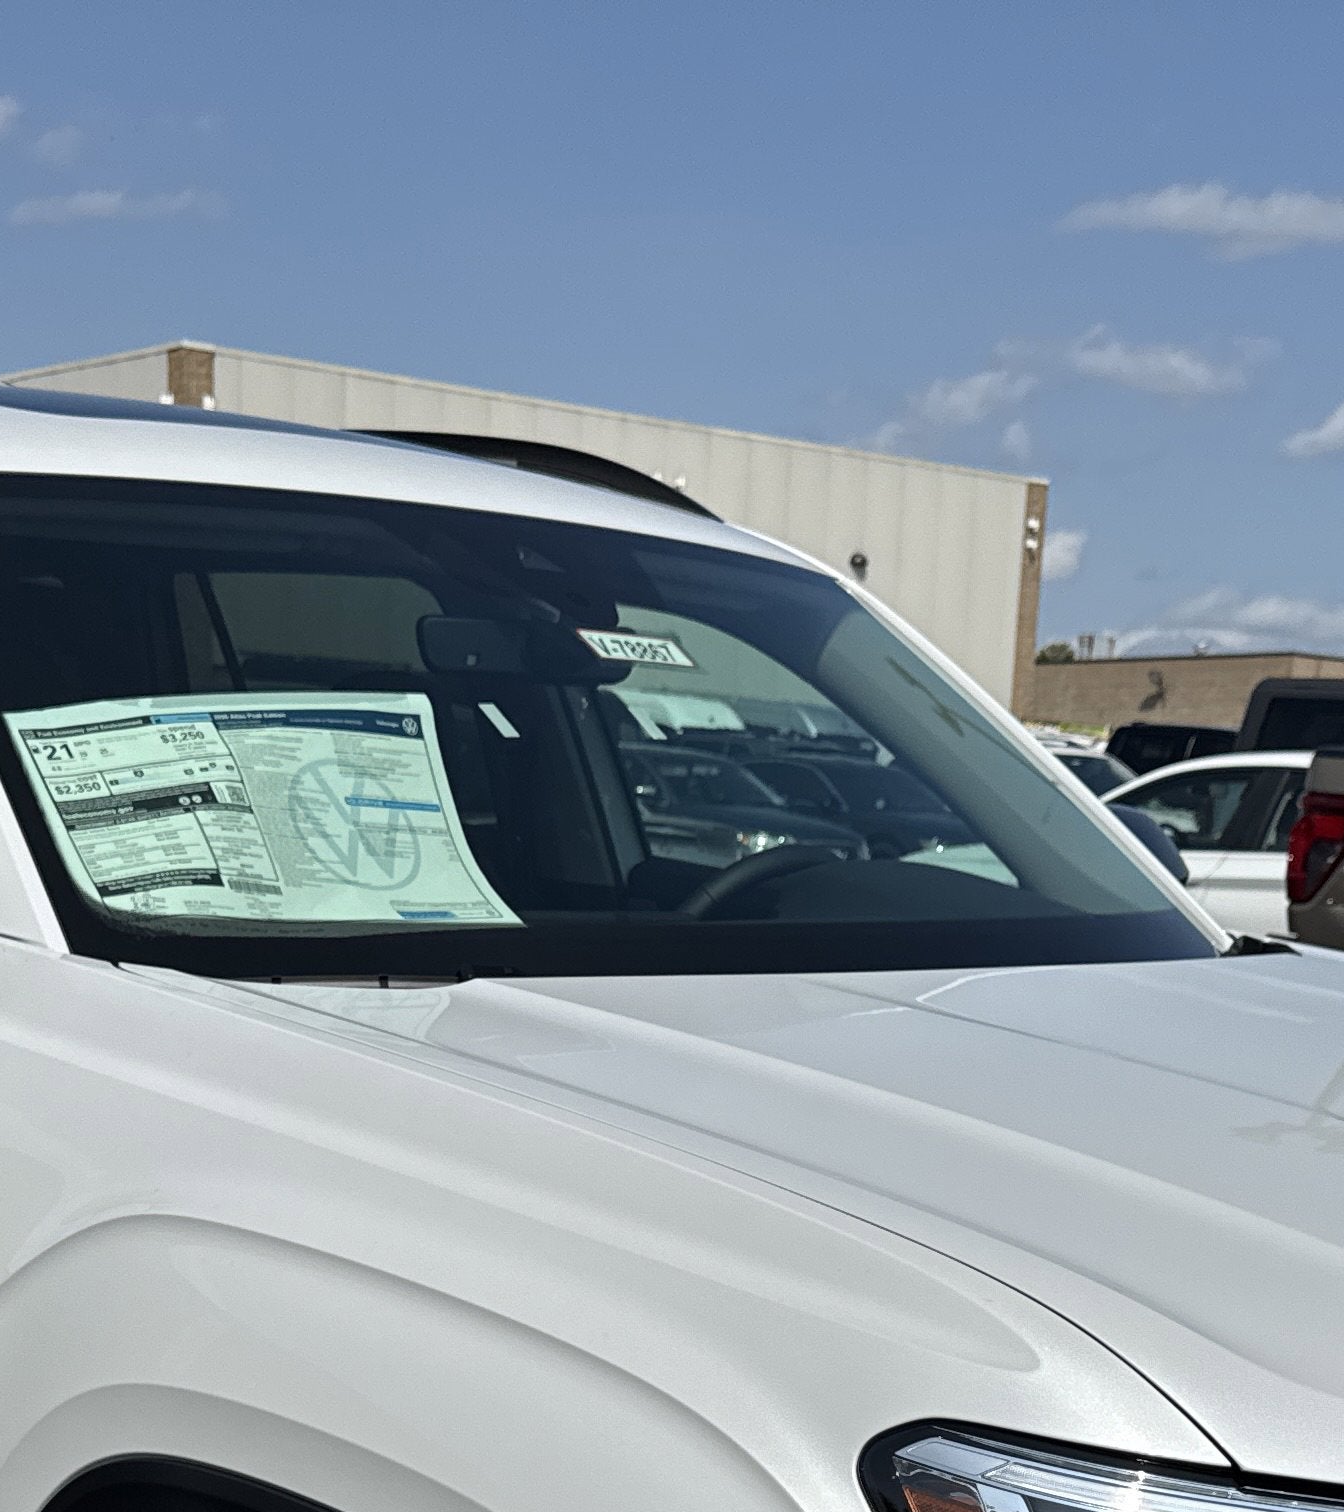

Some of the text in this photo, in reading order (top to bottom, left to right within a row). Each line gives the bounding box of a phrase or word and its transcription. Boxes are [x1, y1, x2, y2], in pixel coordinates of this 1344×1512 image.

[160, 731, 205, 744] $3,250
[42, 743, 75, 761] 21
[55, 782, 102, 796] $2,350
